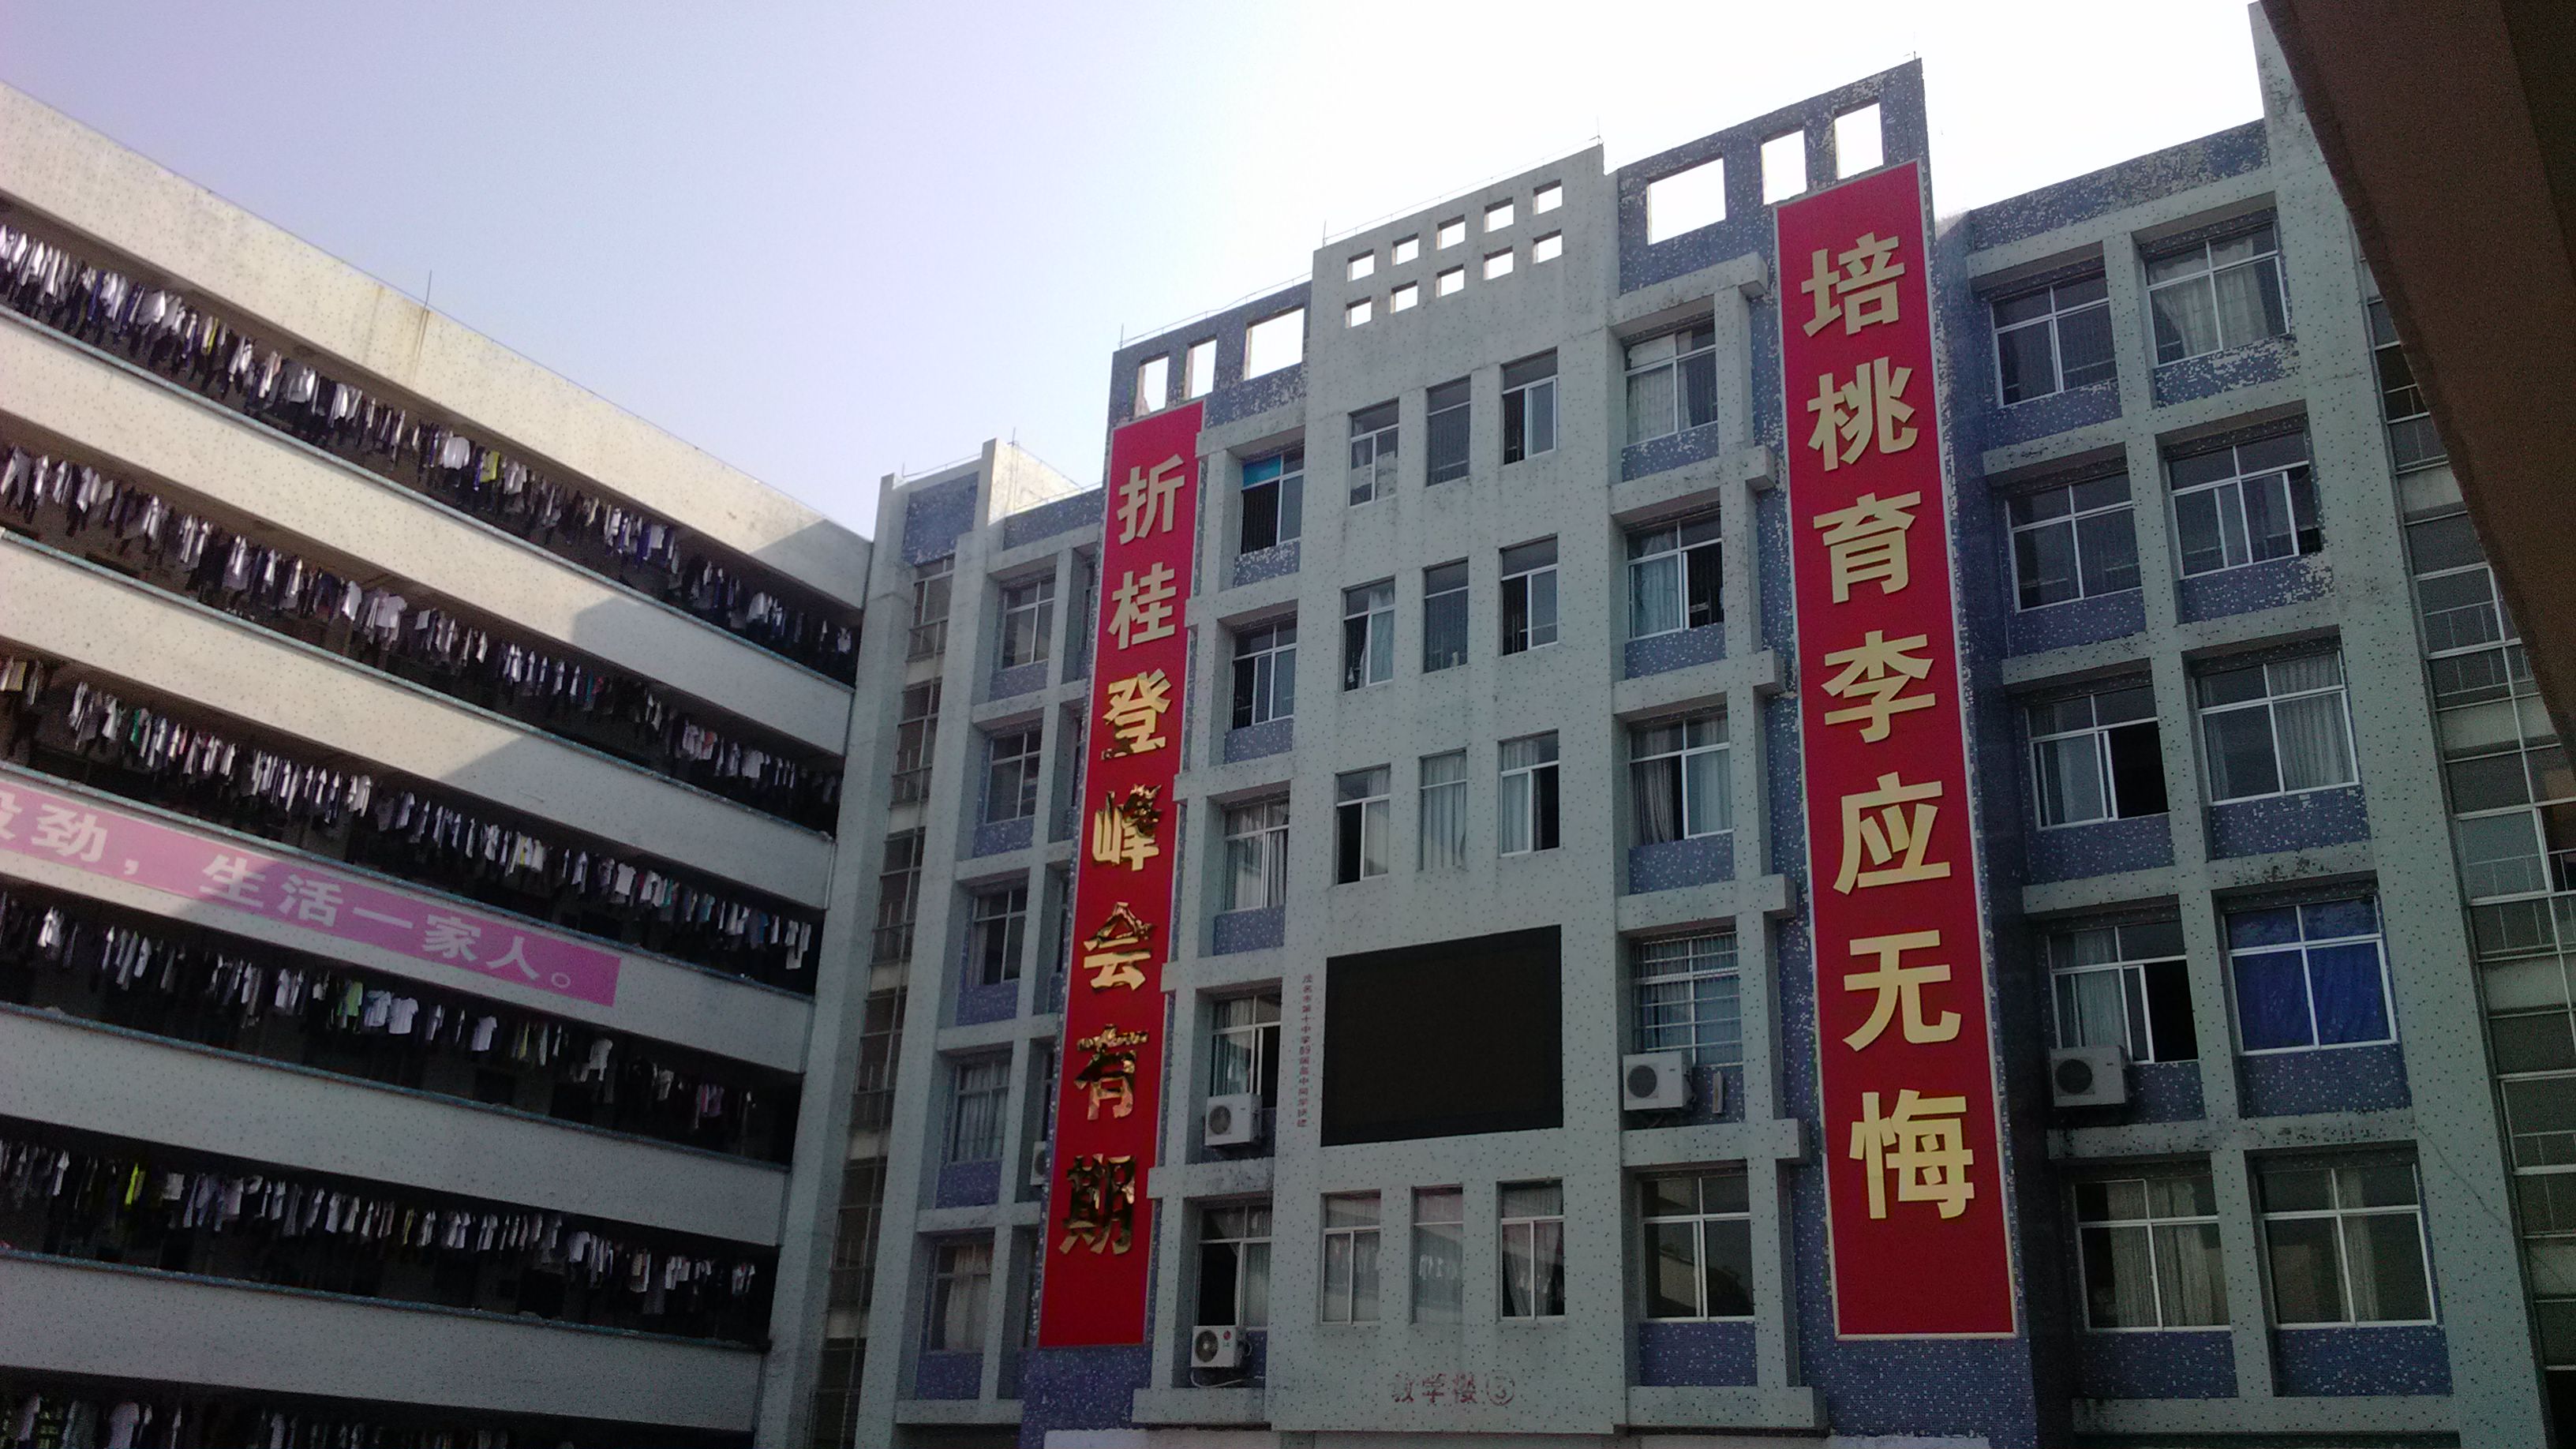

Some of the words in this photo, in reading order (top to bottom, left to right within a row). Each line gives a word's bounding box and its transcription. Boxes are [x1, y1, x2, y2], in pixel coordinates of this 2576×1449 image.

[1058, 453, 1185, 1255] 折桂登峰会有期
[1800, 231, 1975, 1220] 培桃育李应无悔
